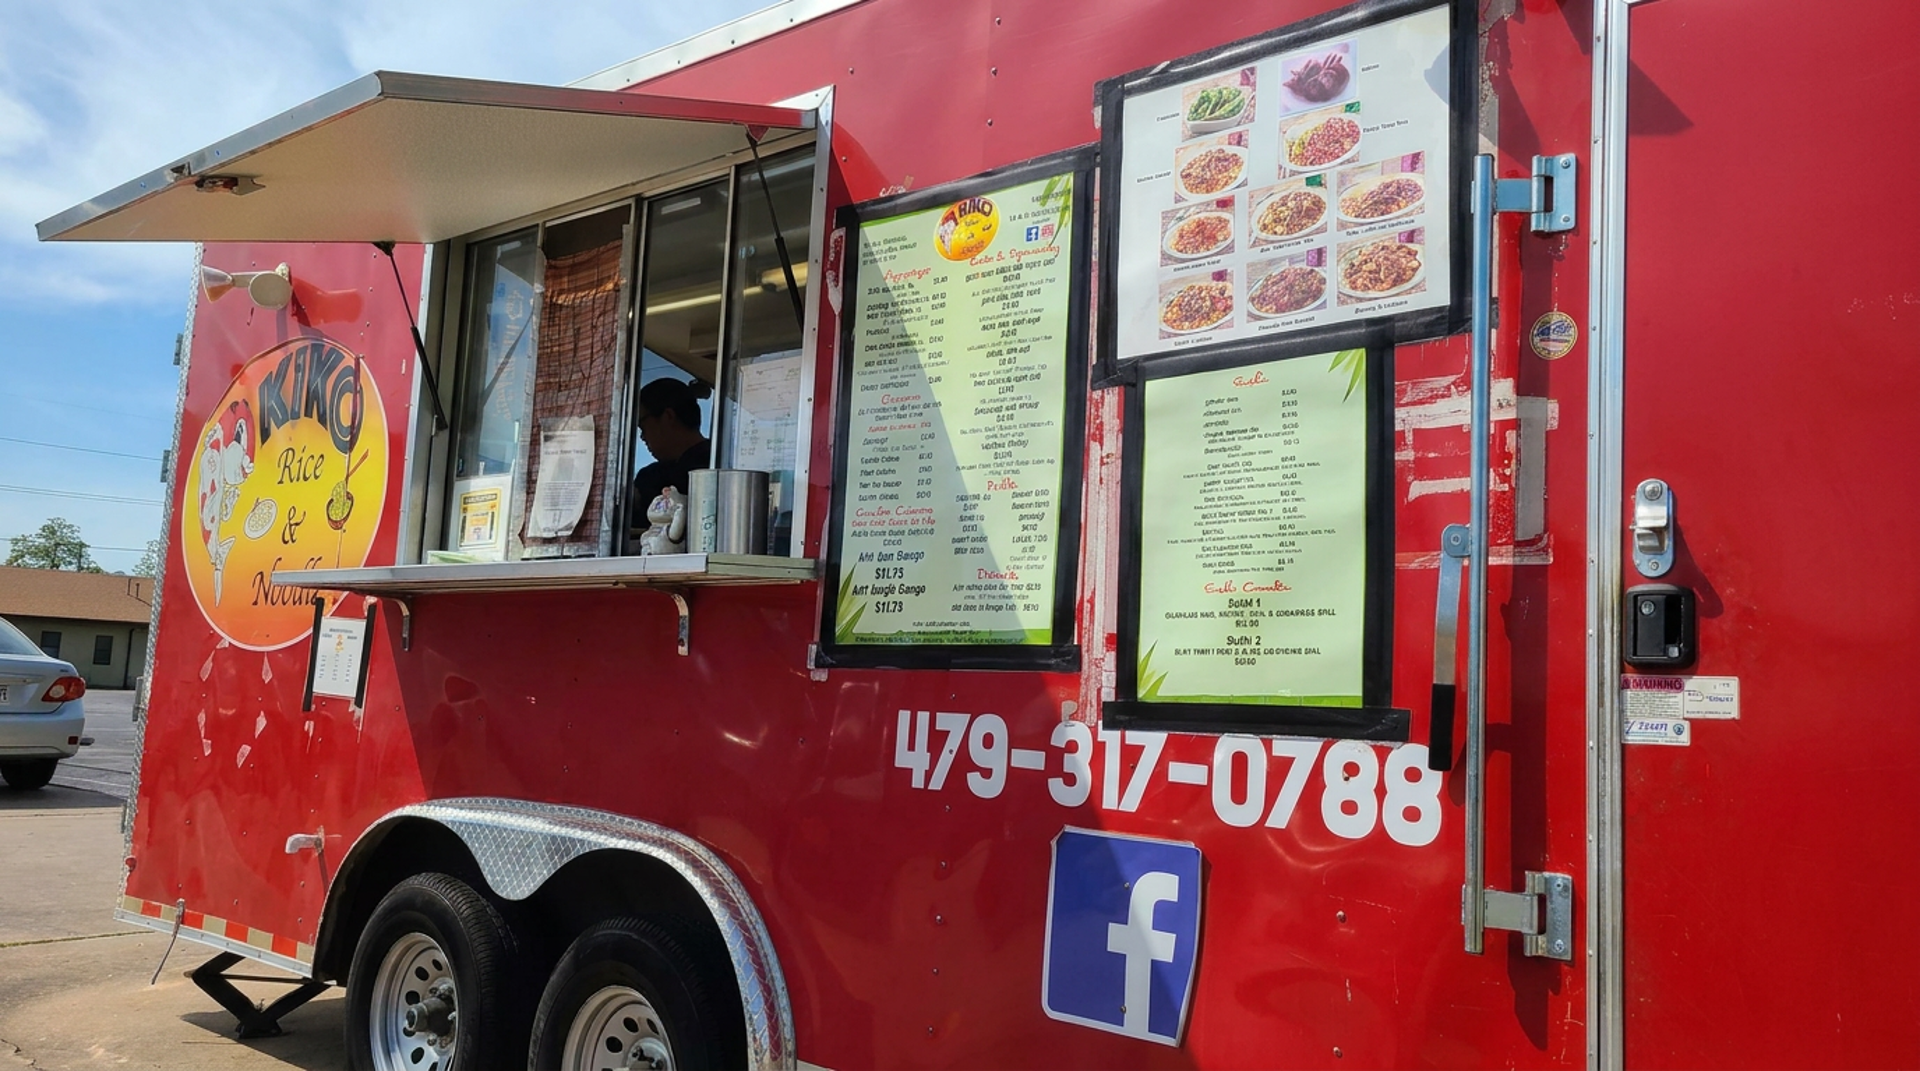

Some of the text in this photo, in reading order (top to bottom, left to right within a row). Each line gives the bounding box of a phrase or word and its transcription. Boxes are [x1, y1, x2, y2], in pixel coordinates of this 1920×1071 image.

[258, 342, 364, 455] KIKO
[277, 445, 325, 484] Rice
[281, 505, 306, 545] &
[894, 709, 1443, 847] 479-317-0788
